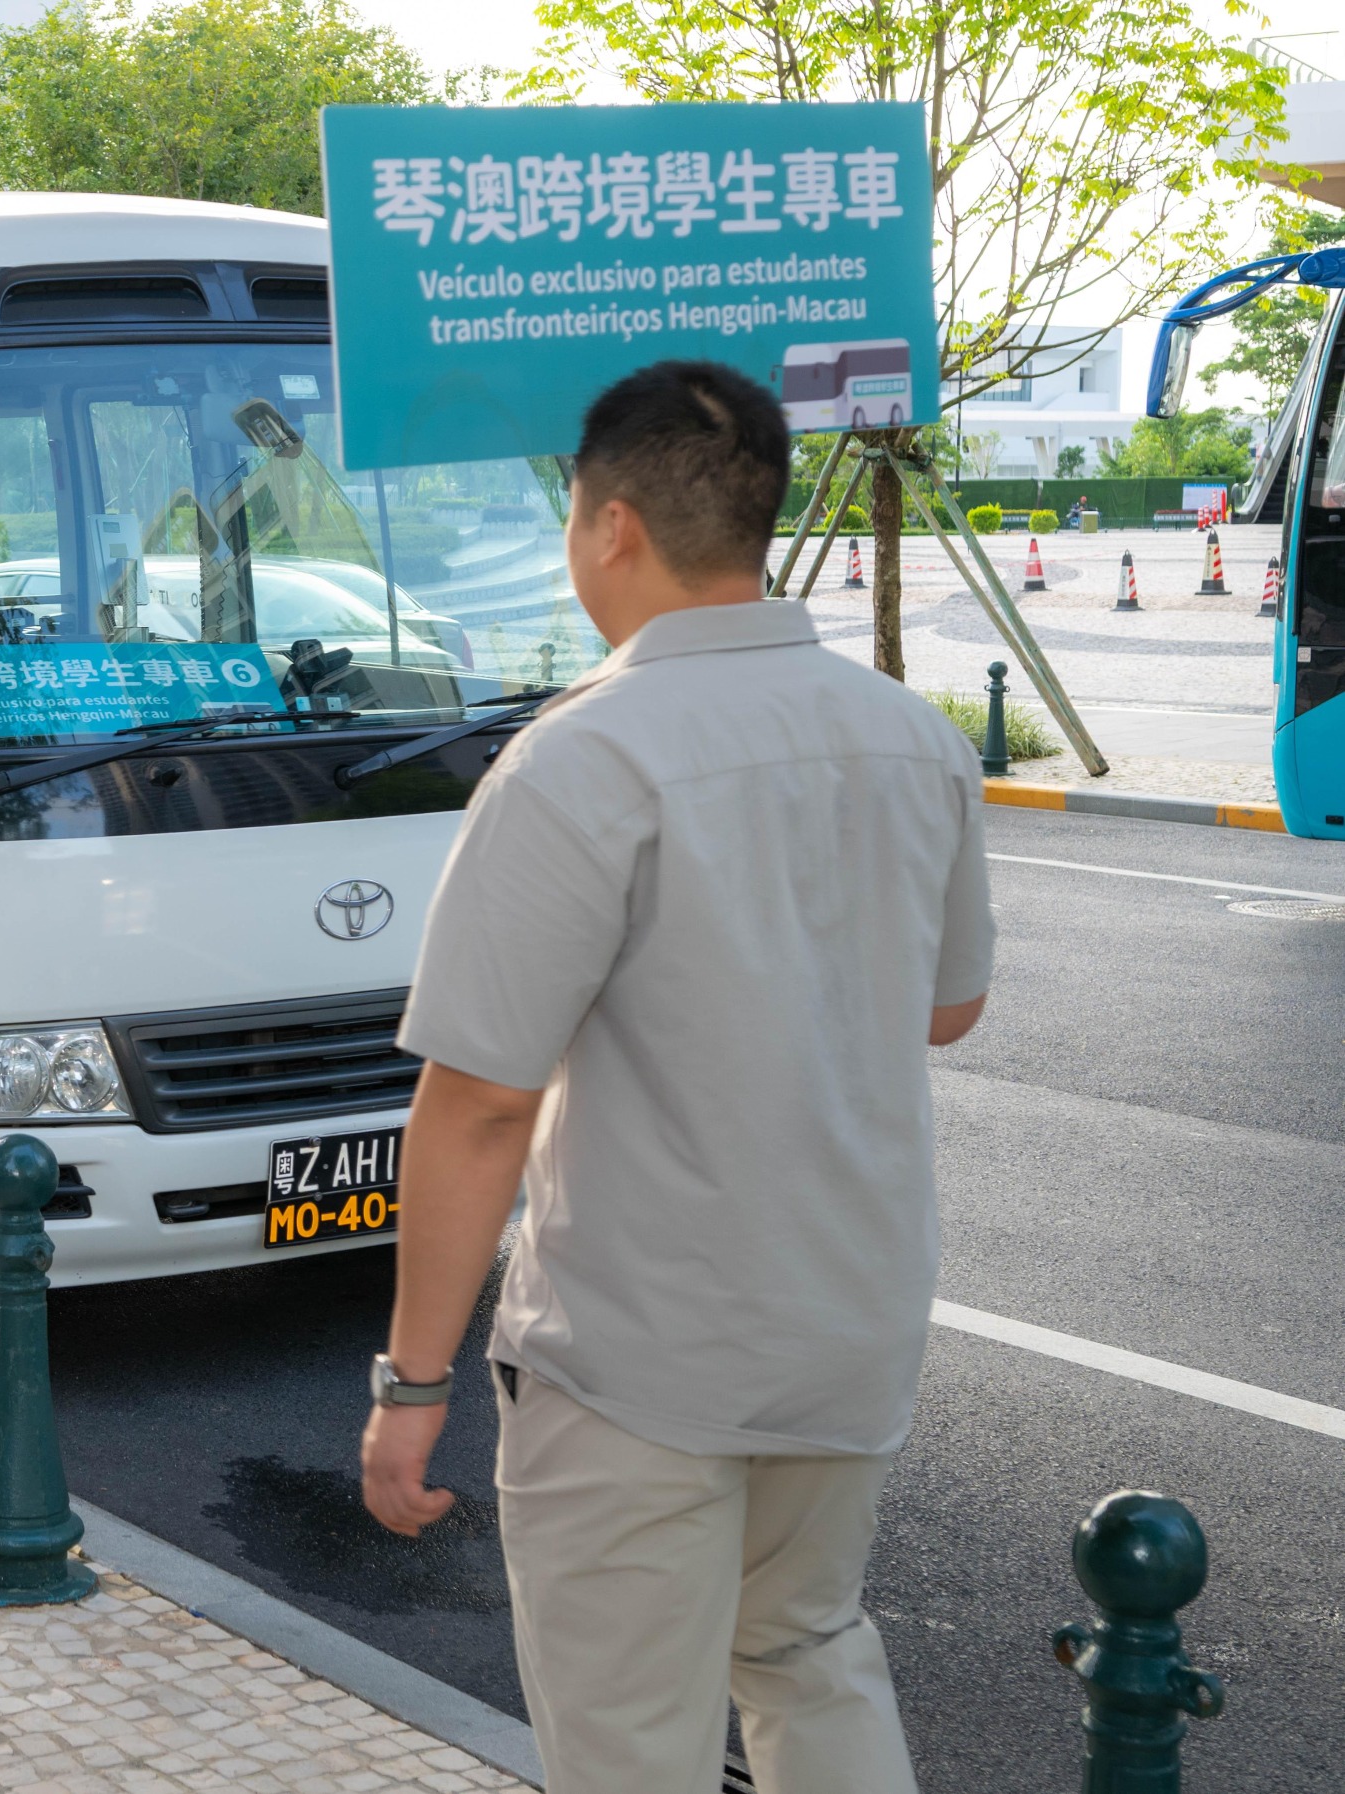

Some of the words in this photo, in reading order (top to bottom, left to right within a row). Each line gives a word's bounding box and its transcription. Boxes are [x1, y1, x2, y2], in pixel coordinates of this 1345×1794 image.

[371, 145, 905, 247] 琴澳跨境學生專車
[418, 263, 525, 301] Veículo
[530, 259, 657, 296] exclusivo
[663, 263, 722, 296] para
[726, 252, 868, 287] estudantes
[429, 302, 663, 345] transfronteiriços
[668, 294, 868, 337] Hengqin-Macau
[48, 696, 86, 709] para
[88, 693, 170, 706] estudantes
[50, 708, 170, 723] Hengqin-Macau
[269, 1192, 402, 1243] MO-40-
